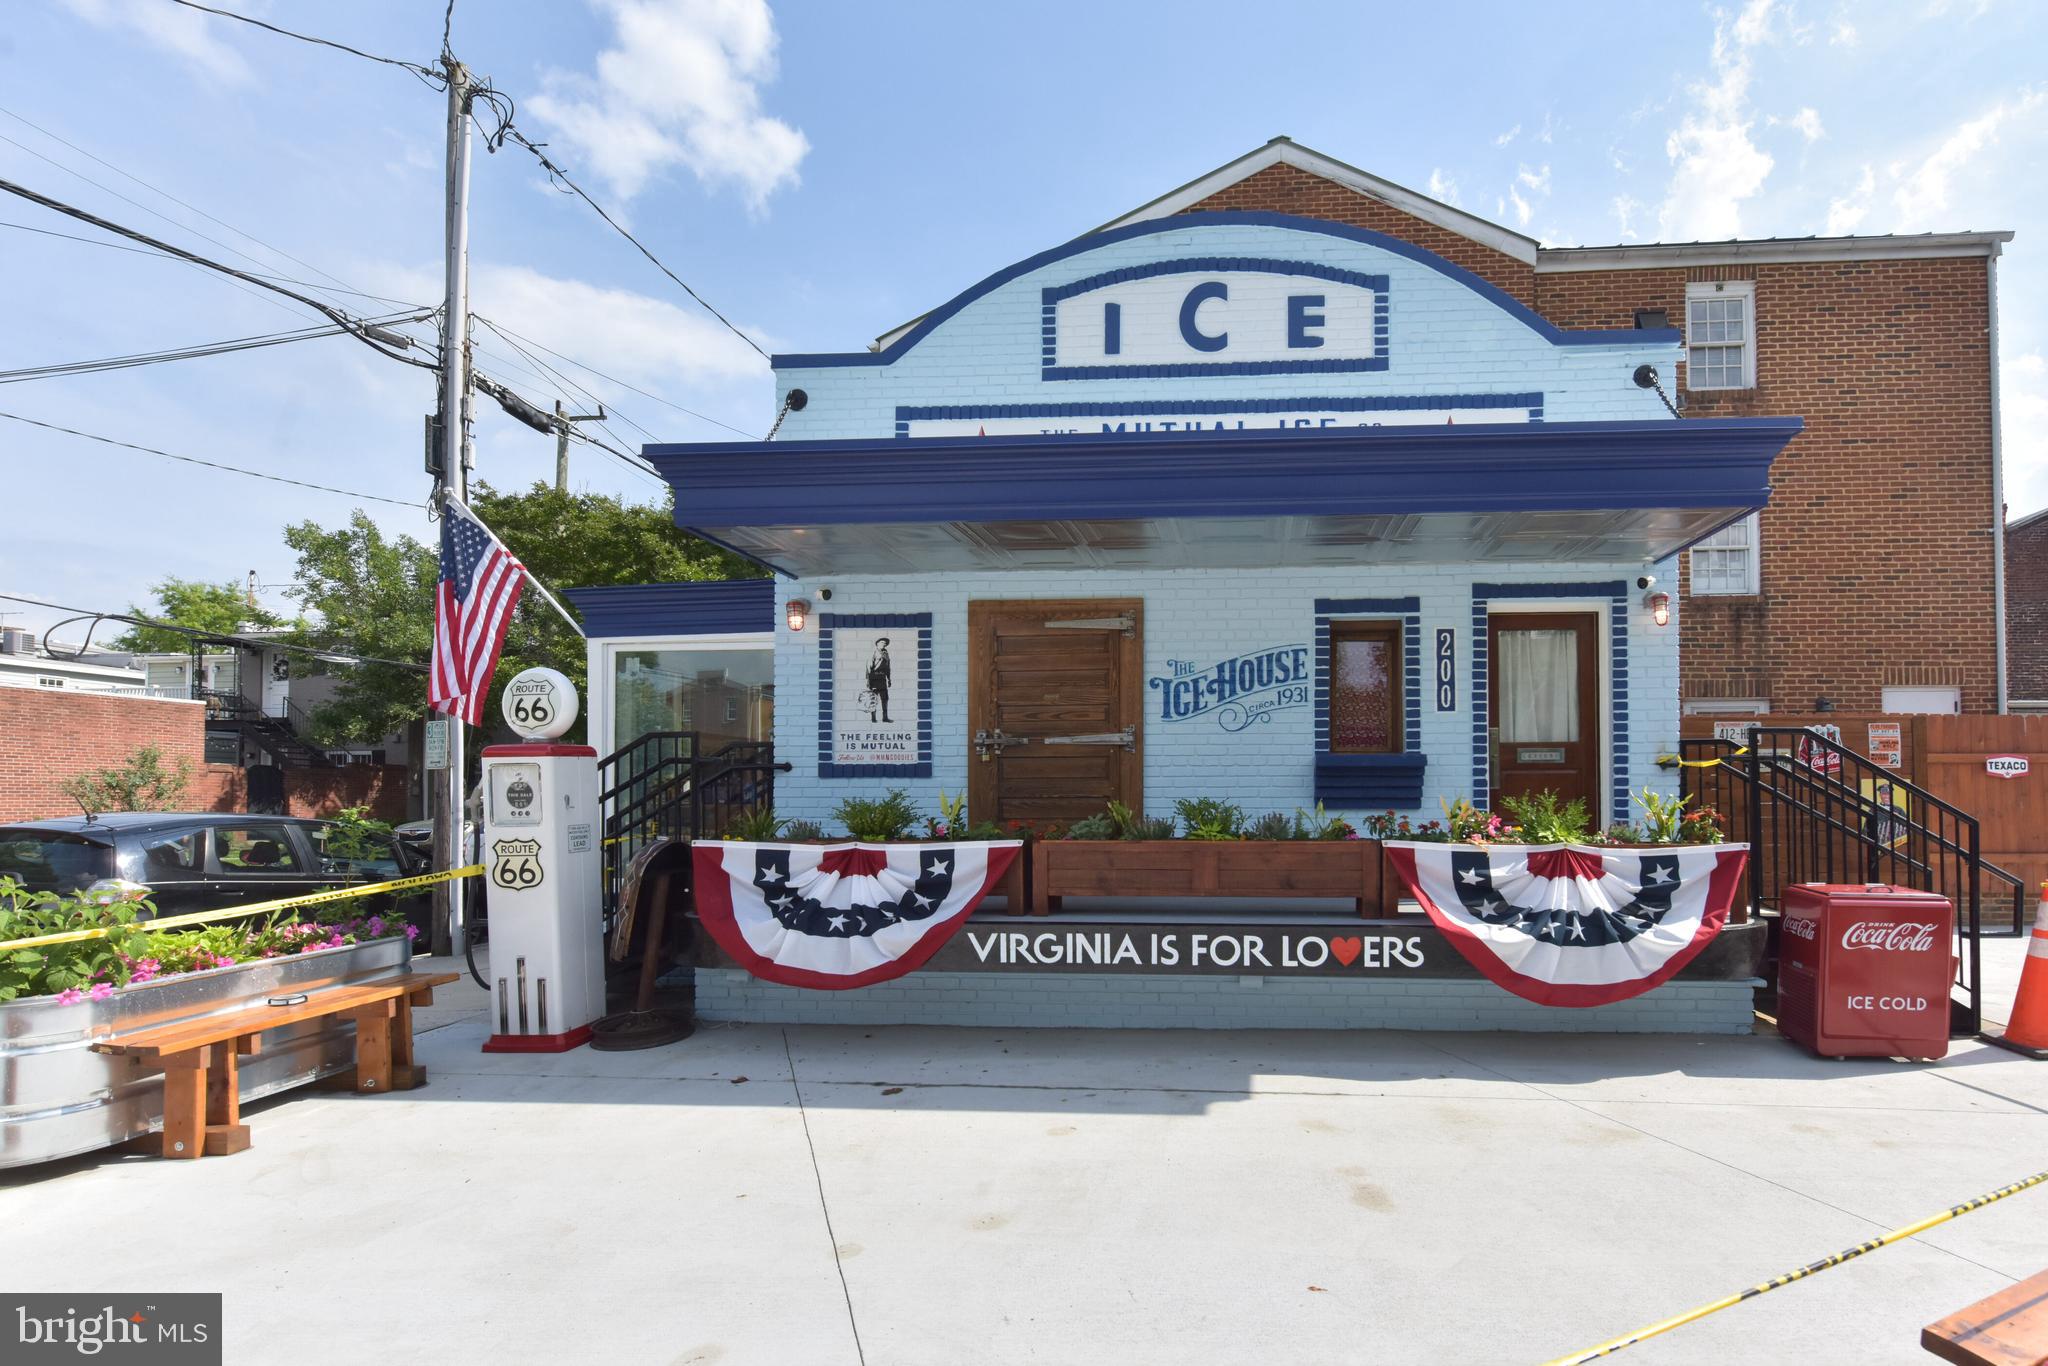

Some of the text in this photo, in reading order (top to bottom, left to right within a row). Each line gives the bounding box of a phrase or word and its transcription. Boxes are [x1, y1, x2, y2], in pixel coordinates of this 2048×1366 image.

[1104, 281, 1326, 355] ICE
[1167, 659, 1195, 677] THE
[1440, 632, 1451, 708] 200
[515, 684, 546, 693] ROUTE
[1150, 648, 1308, 719] ICE HOUSE
[1248, 686, 1308, 712] CIRCA 1931
[514, 697, 549, 723] 66
[840, 733, 912, 741] THE FEELING
[861, 742, 906, 750] MUTUAL
[1811, 752, 1841, 769] CocaCola
[1988, 761, 2027, 771] TEXACO
[500, 844, 535, 854] ROUTE
[573, 840, 586, 848] LEAD
[499, 858, 536, 884] 66
[1841, 921, 1939, 952] Coca-Cola
[967, 932, 1425, 968] VIRGINIA IS FOR LOERS
[1847, 996, 1927, 1011] ICE COLD
